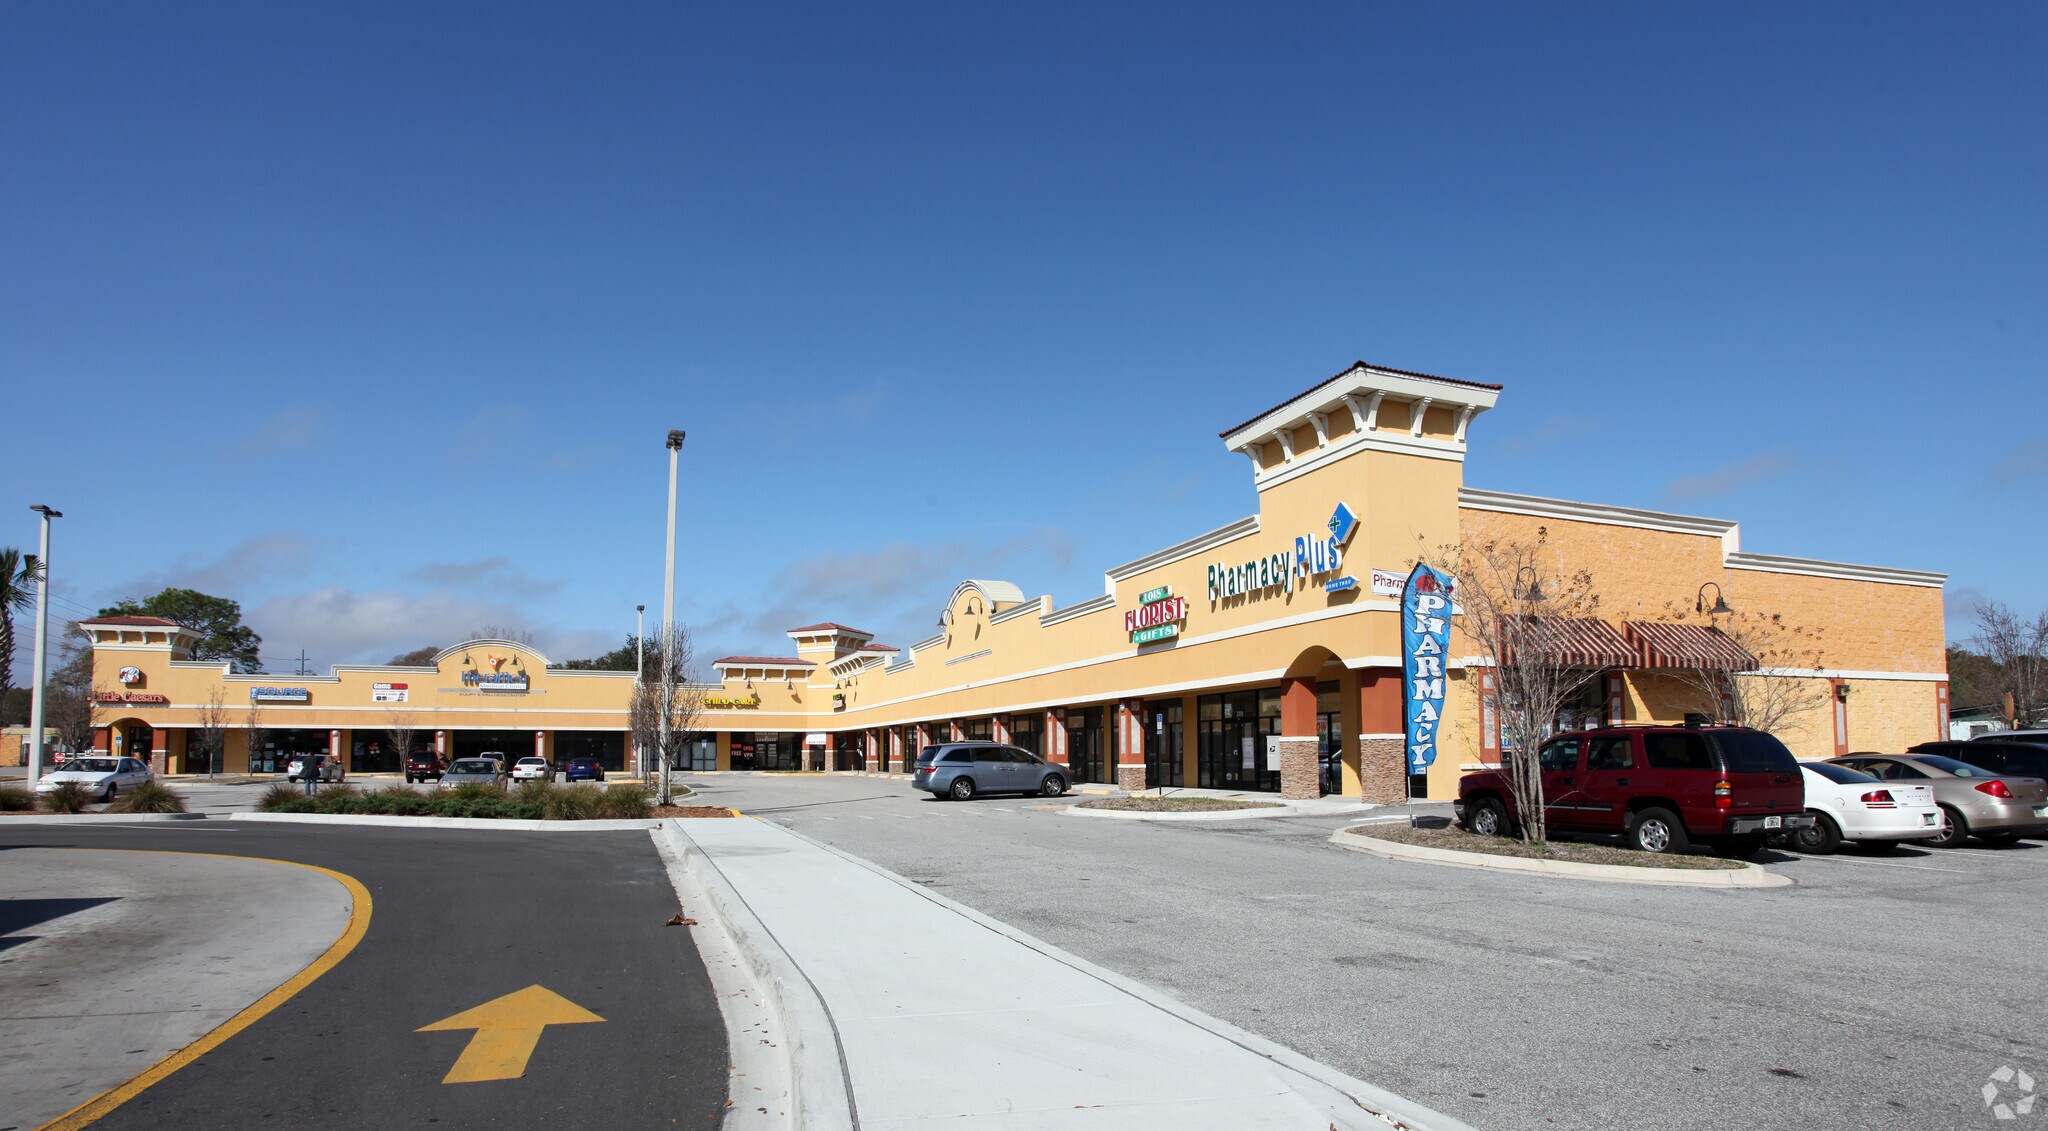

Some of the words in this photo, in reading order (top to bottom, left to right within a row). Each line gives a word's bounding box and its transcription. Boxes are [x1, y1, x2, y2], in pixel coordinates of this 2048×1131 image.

[1208, 551, 1292, 601] Pharmacy
[1295, 533, 1342, 578] Plus
[1339, 579, 1352, 587] THRU
[1373, 573, 1406, 588] Pharm
[1125, 596, 1185, 631] FLORIST
[1140, 626, 1172, 641] GIFTS
[1412, 593, 1446, 765] PHARMACY
[92, 691, 120, 702] Little
[123, 691, 164, 703] Caesars
[257, 687, 307, 696] SOURCE
